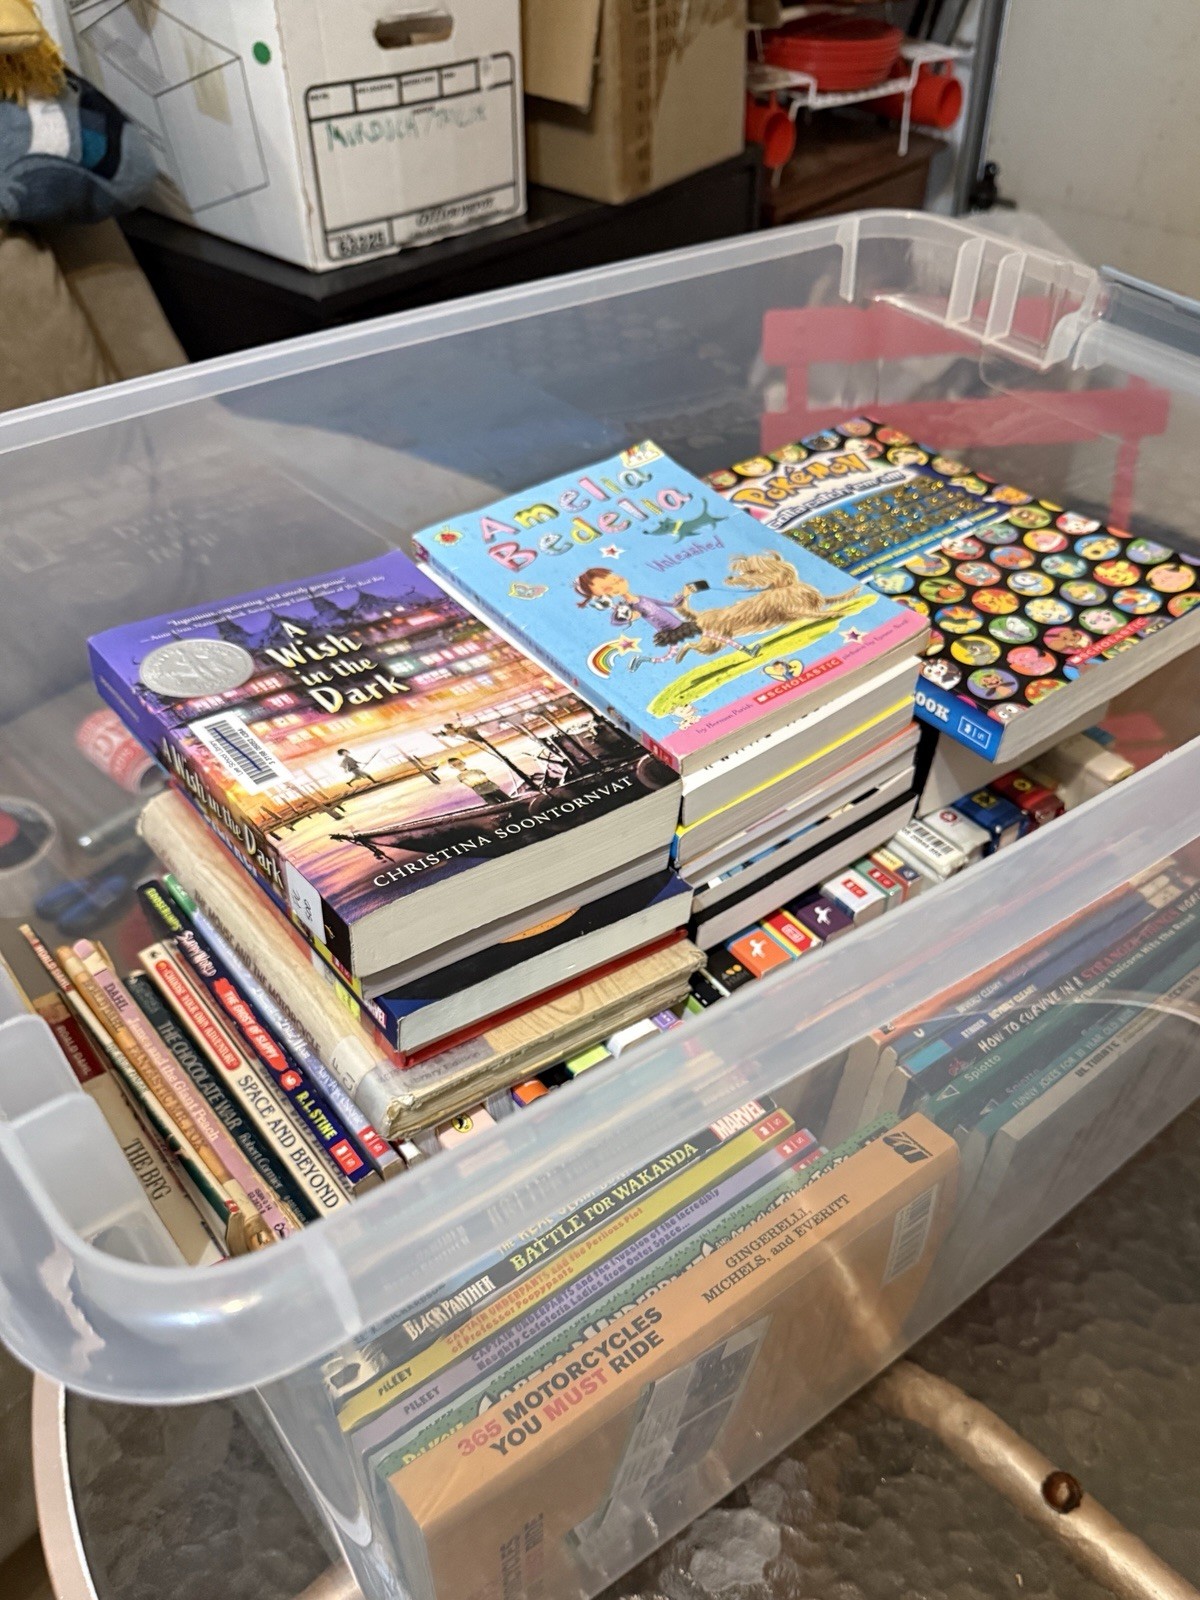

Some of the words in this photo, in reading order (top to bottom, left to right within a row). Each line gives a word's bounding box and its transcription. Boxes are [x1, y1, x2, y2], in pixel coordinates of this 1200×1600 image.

[478, 462, 653, 546] Amelia
[486, 483, 693, 572] Bedelia
[645, 537, 725, 573] Unleashed
[265, 633, 363, 669] Wish
[283, 621, 307, 639] A
[1080, 617, 1150, 661] SCHOLASTIC
[299, 667, 332, 689] in
[330, 656, 378, 680] the
[309, 673, 411, 714] Dark
[766, 658, 841, 700] SCHOLASTIC
[911, 690, 951, 723] OOK
[242, 822, 285, 894] Dark
[373, 835, 492, 888] CHRISTINA
[494, 774, 634, 839] SOONTORNVAT
[221, 988, 237, 1008] THE
[235, 1004, 255, 1031] GHOST
[249, 1024, 262, 1041] OF
[256, 1032, 281, 1062] SLAPPY
[234, 943, 252, 967] AND
[252, 964, 270, 987] THE
[268, 981, 322, 1051] MOTORCYCLE
[977, 1030, 1006, 1053] HOW
[1002, 1021, 1021, 1038] TO
[1059, 981, 1076, 1000] IN
[103, 981, 130, 1012] DAHL
[127, 1016, 155, 1052] James
[151, 1046, 168, 1072] and
[162, 1064, 178, 1086] the
[172, 1077, 200, 1116] Giant
[192, 1107, 220, 1142] Peach
[128, 1042, 175, 1105] FANTASTIC
[159, 1019, 179, 1047] THE
[173, 1039, 220, 1104] CHOCOLATE
[212, 1096, 243, 1131] WAR
[1074, 1039, 1122, 1081] ULTIMATE
[238, 1074, 270, 1119] SPACE
[267, 1116, 297, 1150] AND
[288, 1142, 339, 1211] BEYOND
[309, 1108, 338, 1140] STINE
[711, 1100, 767, 1140] MARVEL
[123, 1137, 150, 1177] THE
[140, 1168, 173, 1201] BFG
[402, 1306, 446, 1342] BLACK
[439, 1275, 497, 1320] PANTHER
[509, 1212, 586, 1272] BATTLE
[583, 1194, 616, 1222] FOR
[611, 1142, 699, 1202] WAKANDA
[701, 1250, 772, 1304] MICHELS,
[769, 1232, 796, 1257] and
[798, 1193, 852, 1236] EVERITT
[725, 1206, 813, 1269] GINGERELLI,
[403, 1385, 441, 1416] PILKEY
[515, 1287, 575, 1333] UNDERPANTS
[575, 1272, 594, 1292] and
[611, 1235, 651, 1268] Invasion
[659, 1217, 677, 1233] the
[675, 1187, 721, 1223] Incredibly
[463, 1303, 516, 1347] Professor
[516, 1266, 575, 1311] Poopypants
[521, 1302, 572, 1340] Cafeteria
[570, 1279, 604, 1307] Ladies
[602, 1263, 628, 1287] from
[626, 1246, 654, 1270] Outer
[377, 1366, 414, 1397] PILKEY
[487, 1269, 551, 1316] UNDERPANTS
[457, 1418, 502, 1458] 365
[502, 1306, 663, 1427] MOTORCYCLES
[490, 1414, 543, 1457] YOU
[541, 1368, 609, 1422] MUST
[608, 1329, 665, 1375] RIDE
